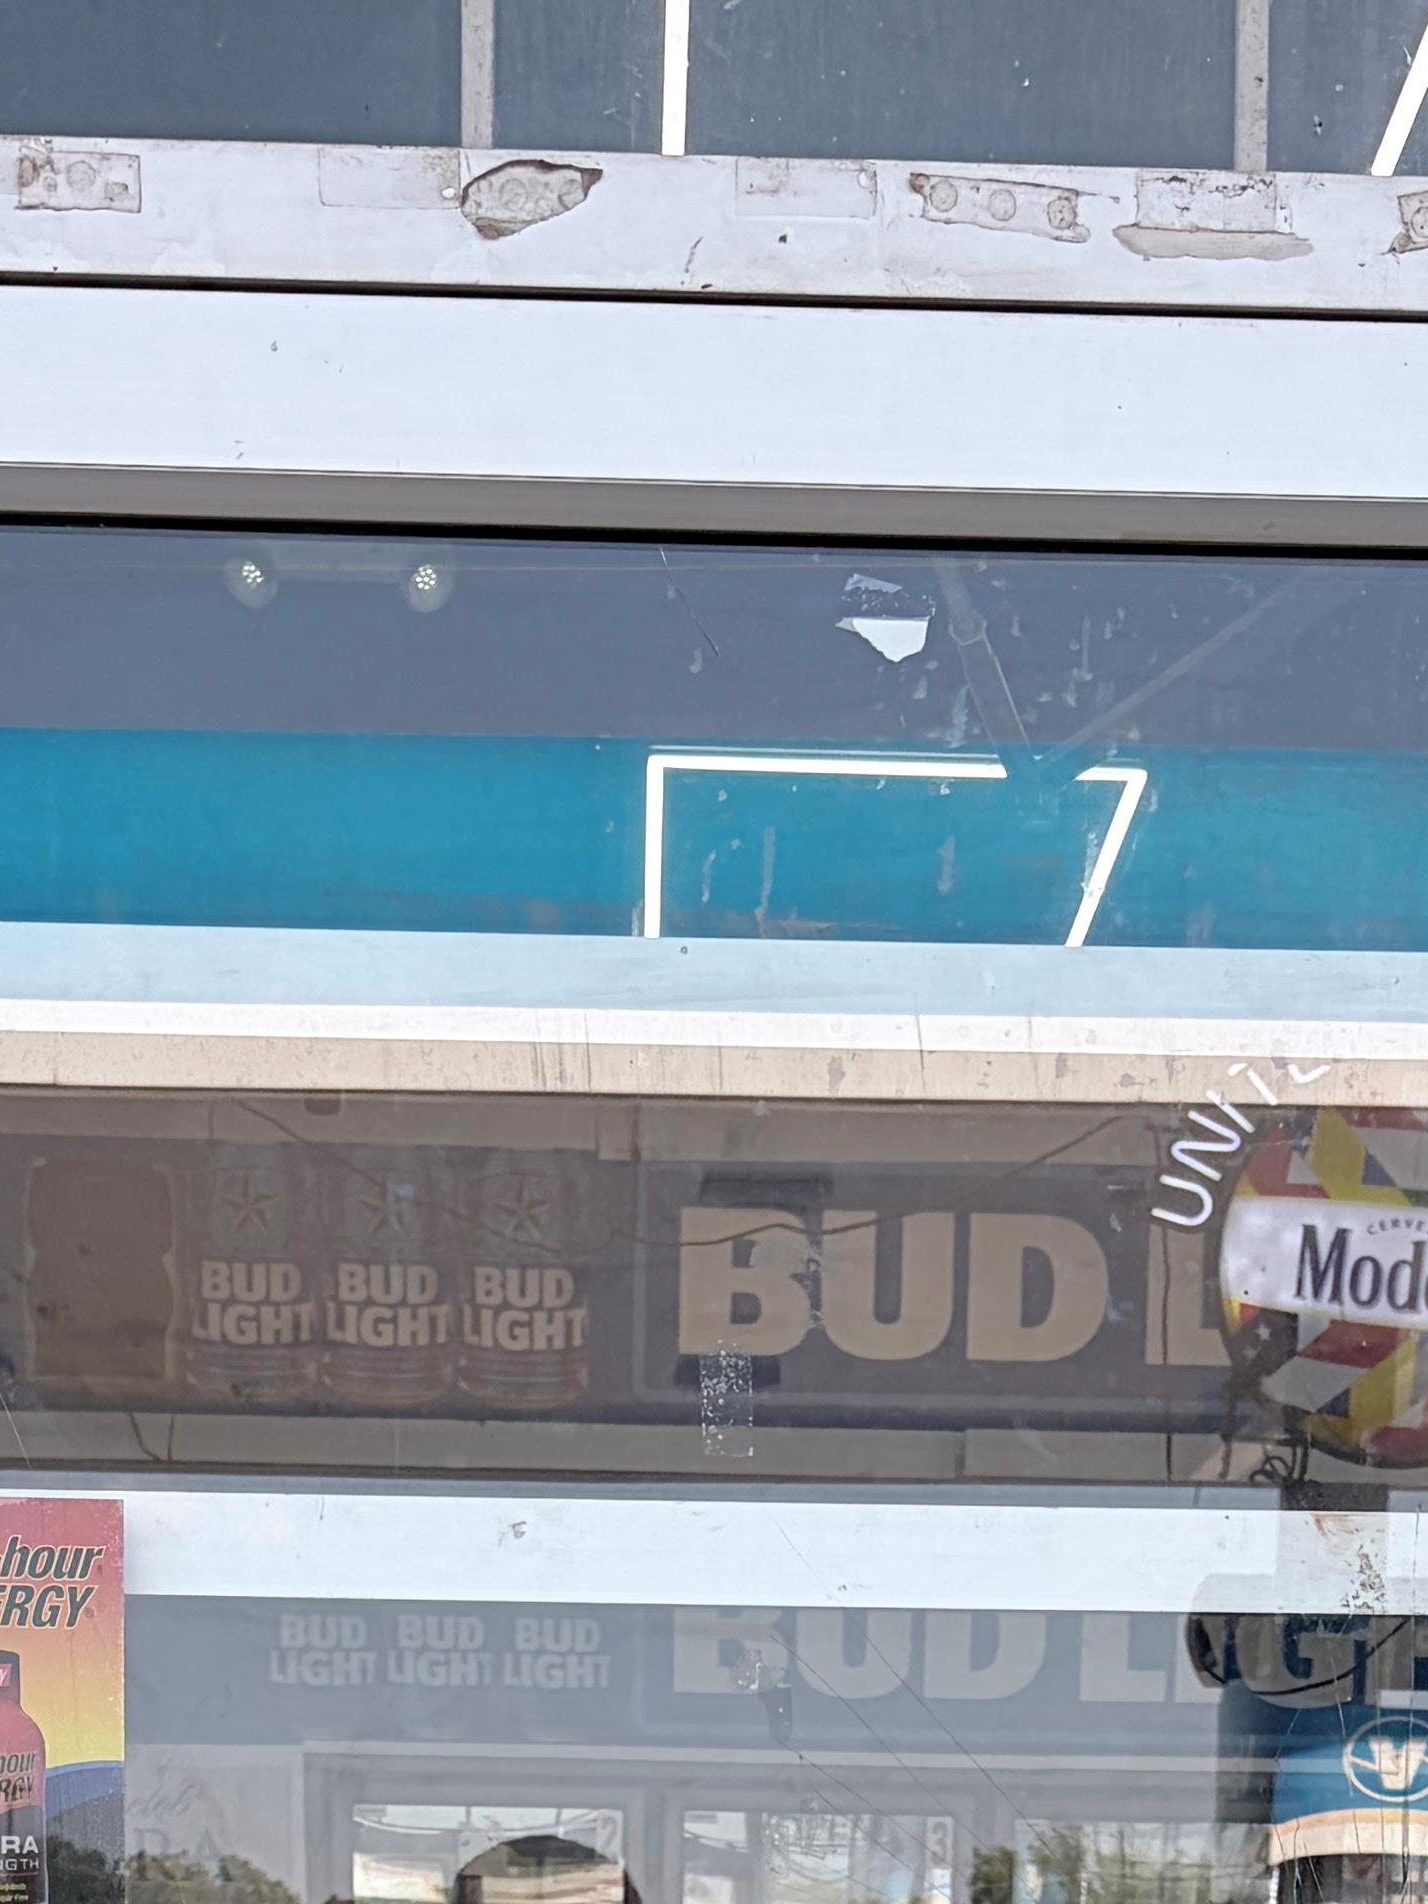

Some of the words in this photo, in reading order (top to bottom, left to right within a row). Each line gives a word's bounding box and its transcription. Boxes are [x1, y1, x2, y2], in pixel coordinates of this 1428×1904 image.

[201, 1260, 302, 1306] BUD
[337, 1262, 440, 1307] BUD
[472, 1267, 574, 1311] BUD
[678, 1205, 1108, 1364] BUD
[191, 1302, 316, 1348] LIGHT
[326, 1302, 451, 1349] LIGHT
[460, 1306, 588, 1353] LIGHT
[280, 1614, 368, 1651] BUD
[397, 1614, 486, 1652] BUD
[515, 1617, 603, 1653] BUD
[269, 1649, 378, 1687] LIGHT
[387, 1650, 495, 1687] LIGHT
[502, 1651, 613, 1690] LIGHT
